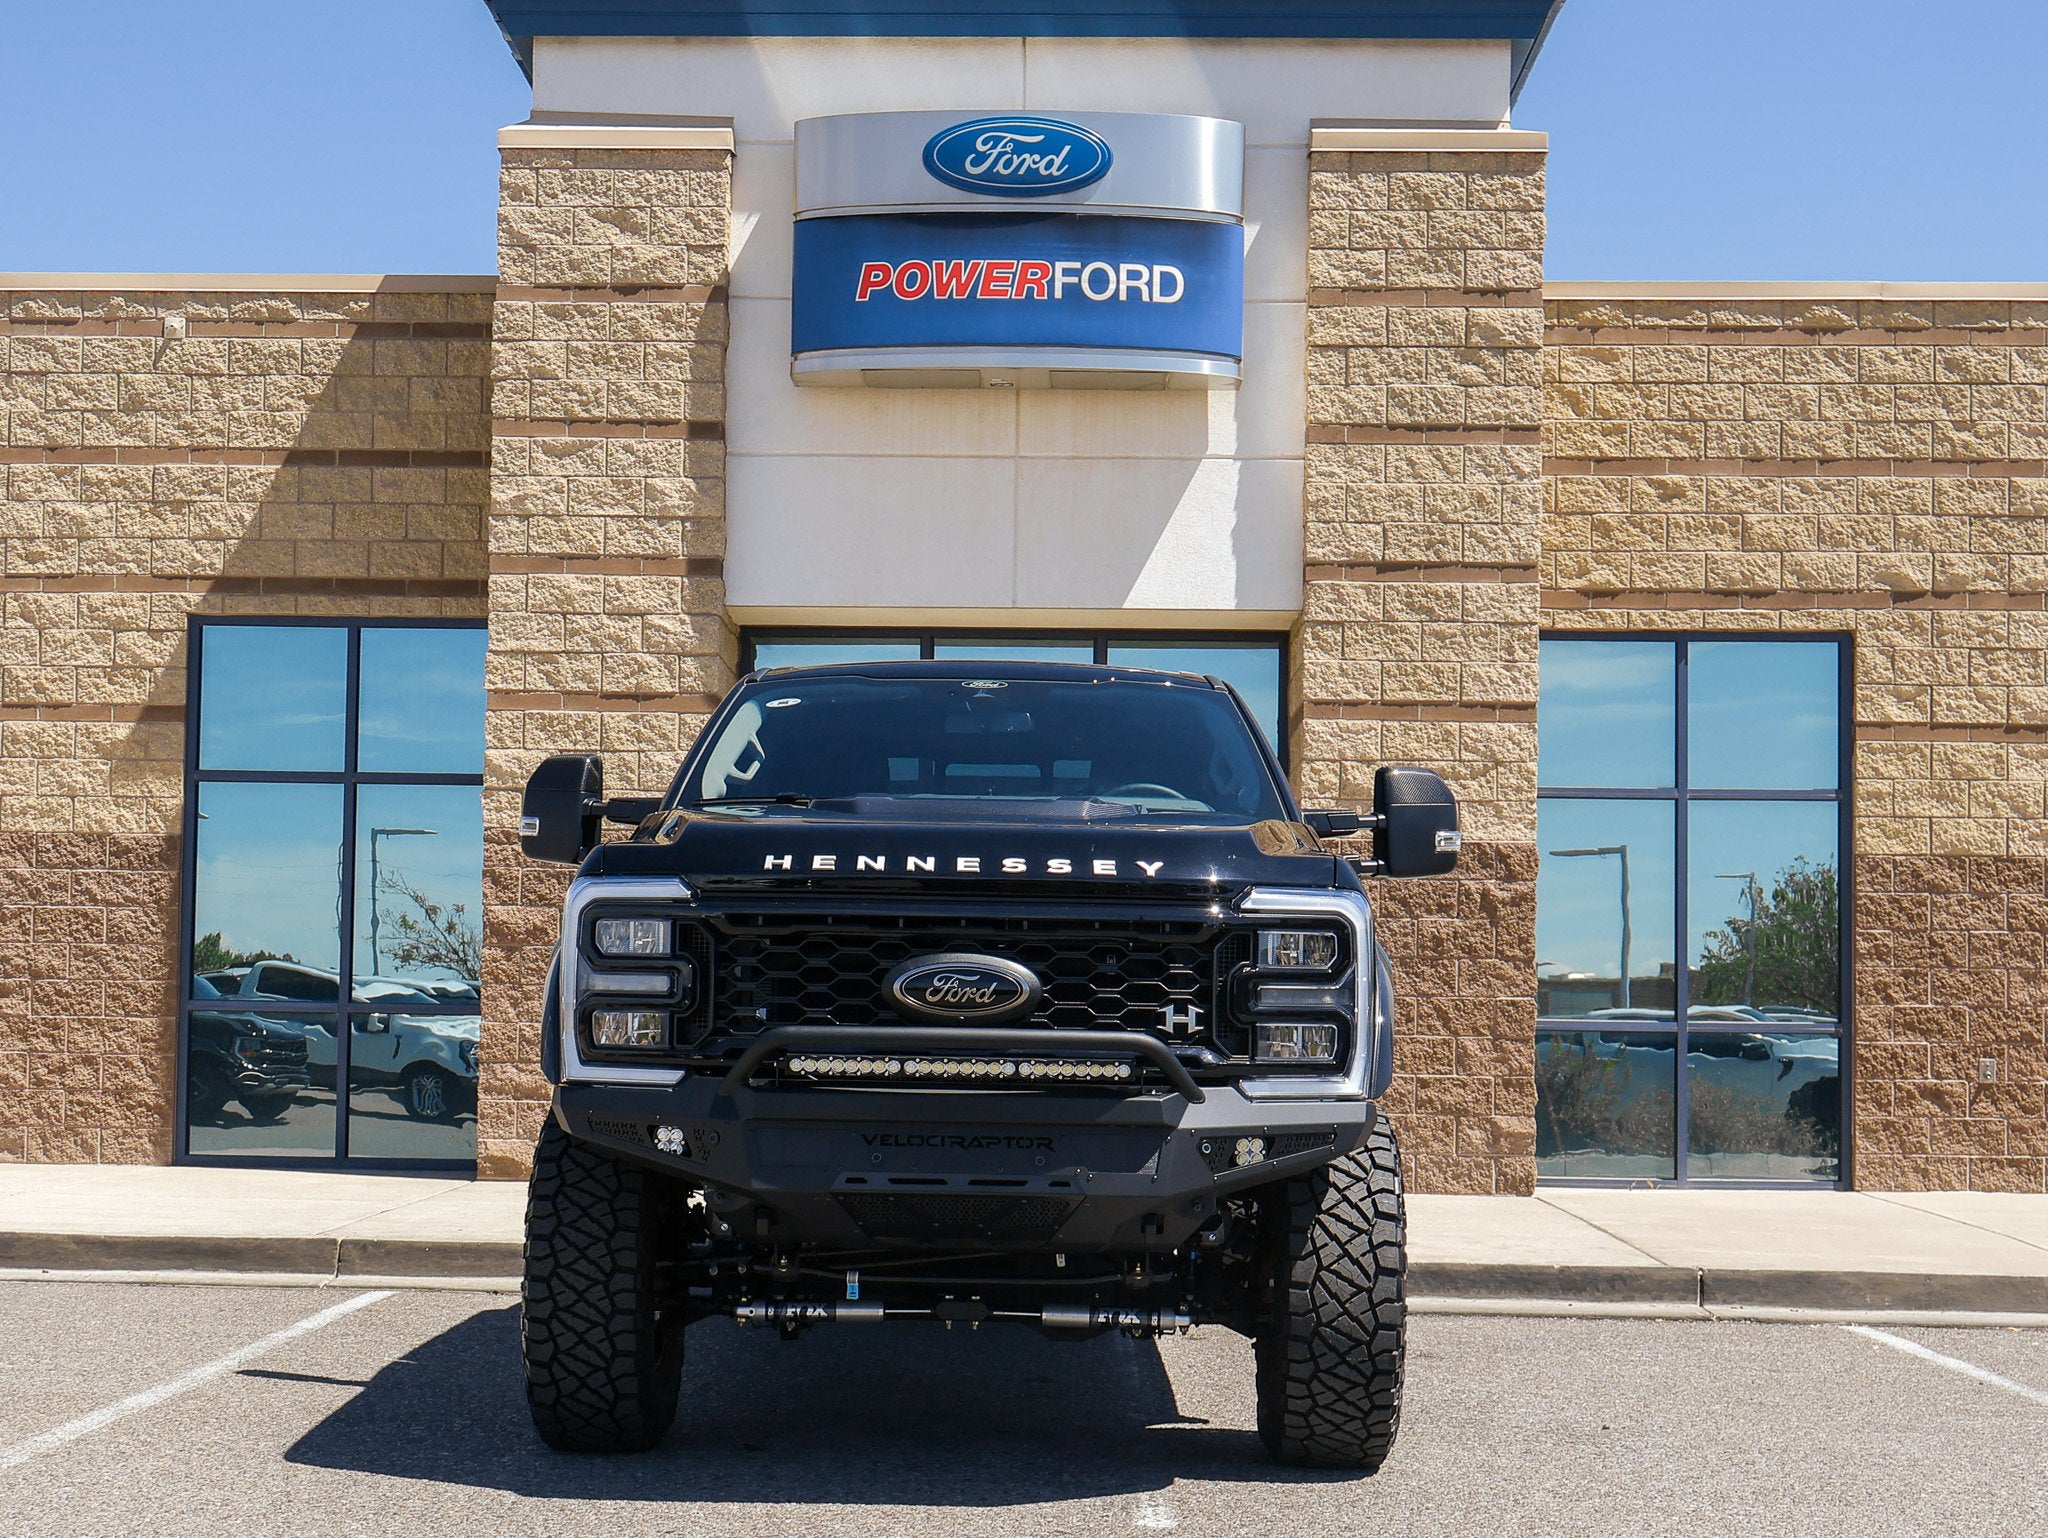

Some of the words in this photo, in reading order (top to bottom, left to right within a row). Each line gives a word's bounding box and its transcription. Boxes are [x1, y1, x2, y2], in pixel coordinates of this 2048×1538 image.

[963, 131, 1072, 176] Ford
[763, 854, 1164, 877] HENNESSEY
[925, 973, 998, 1003] Ford
[861, 1133, 1055, 1152] VELOCIRAPTOR
